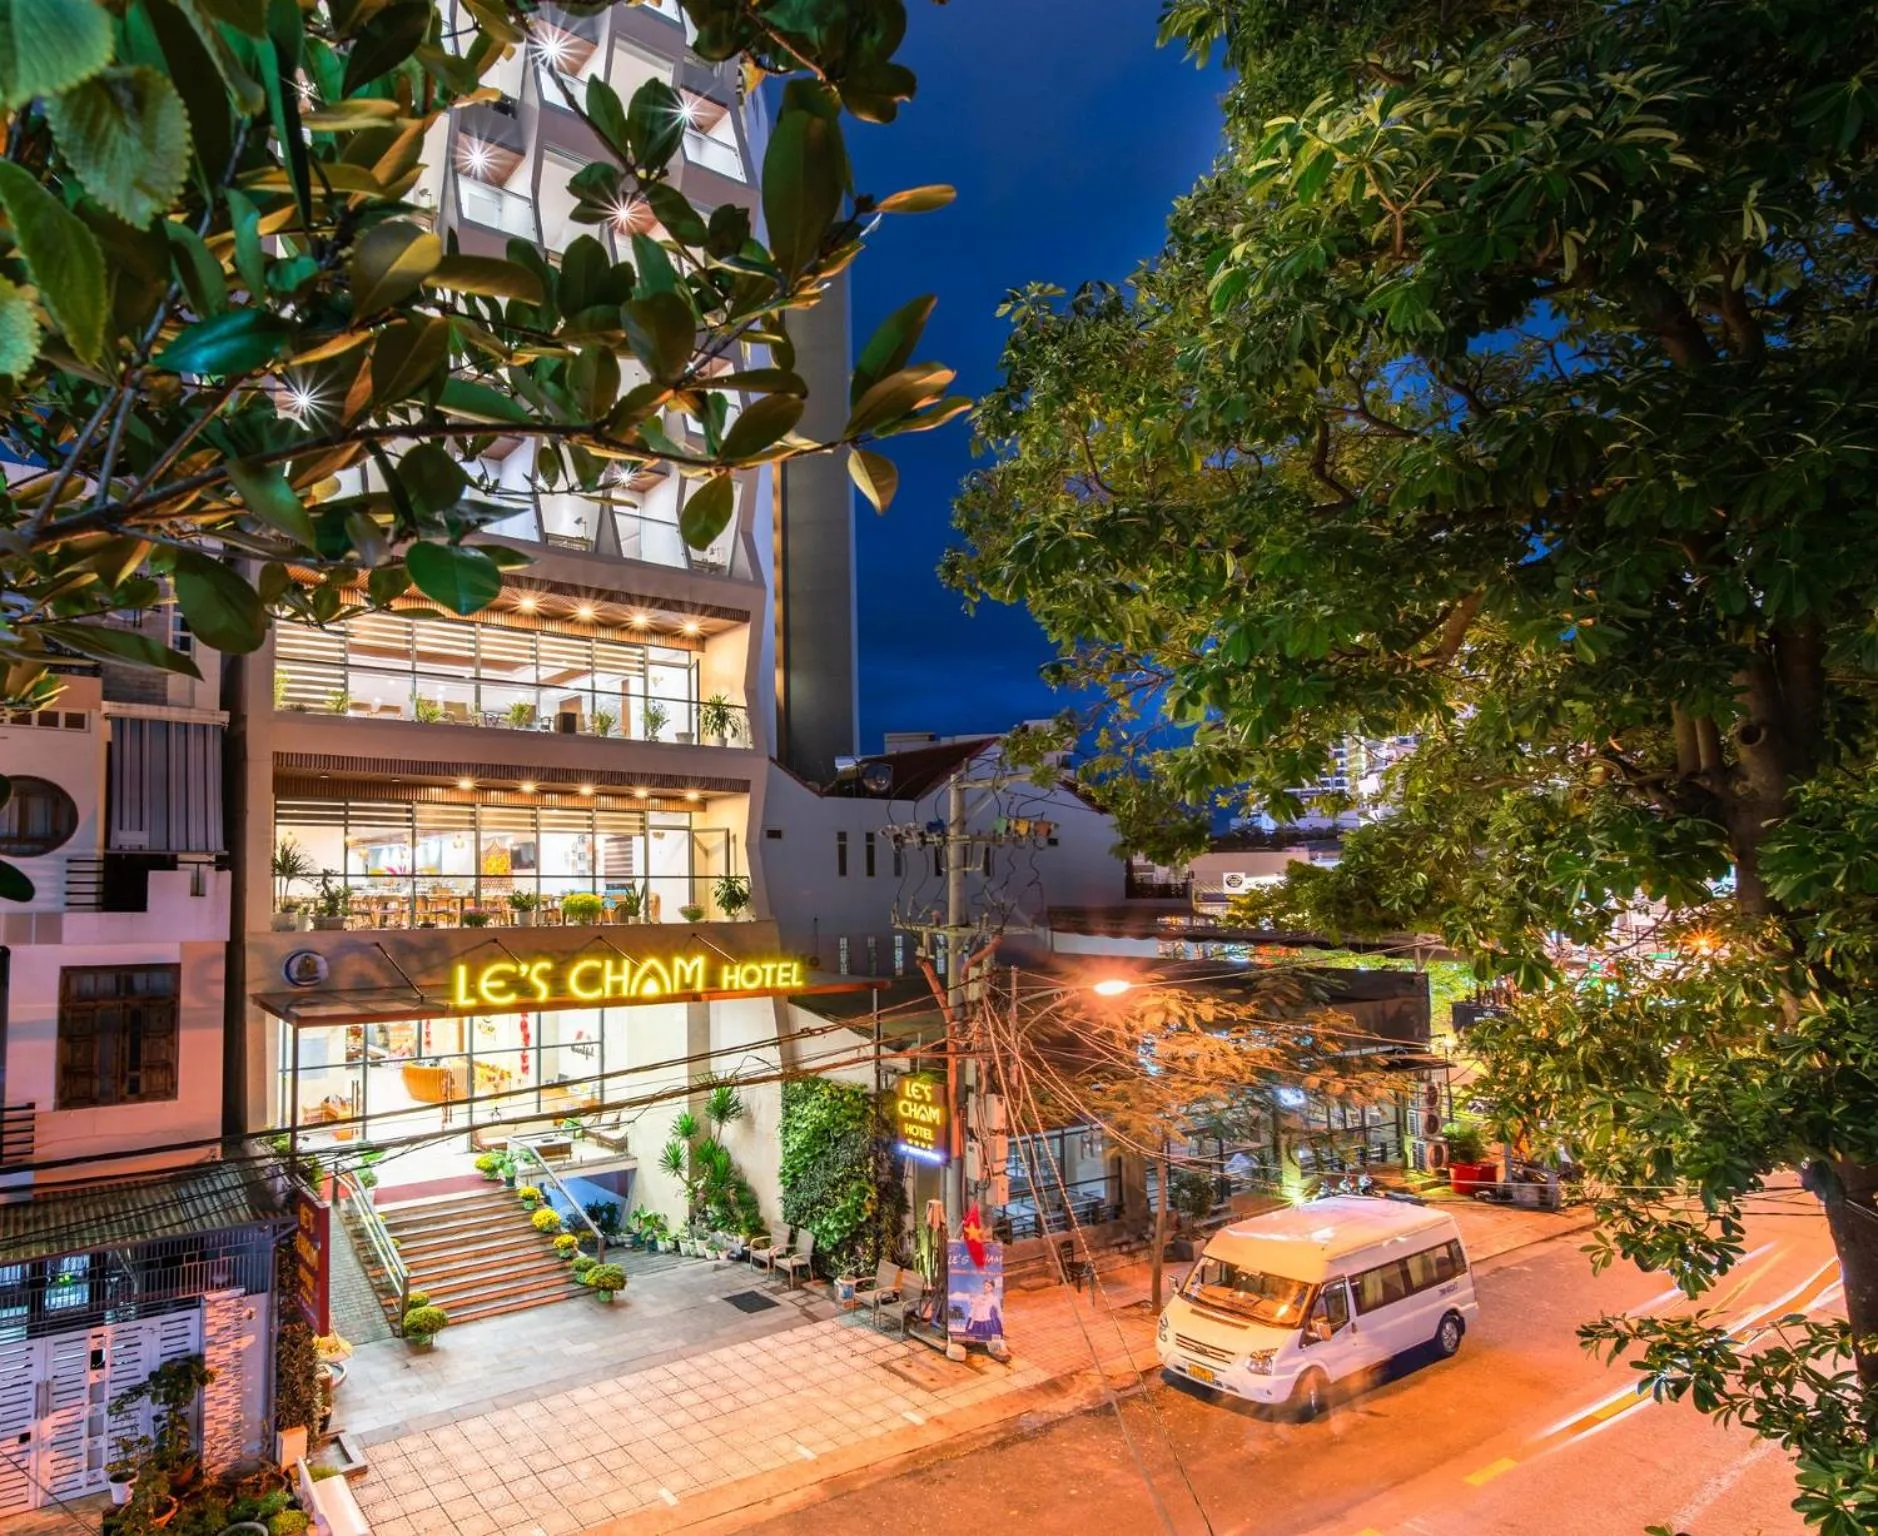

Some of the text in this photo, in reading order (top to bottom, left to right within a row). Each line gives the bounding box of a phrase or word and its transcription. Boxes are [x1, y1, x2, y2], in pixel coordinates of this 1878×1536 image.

[456, 956, 804, 1006] LE'S CHAM HOTEL
[904, 1080, 932, 1101] LE'S
[898, 1100, 941, 1125] CHAM
[904, 1123, 934, 1140] HOTEL
